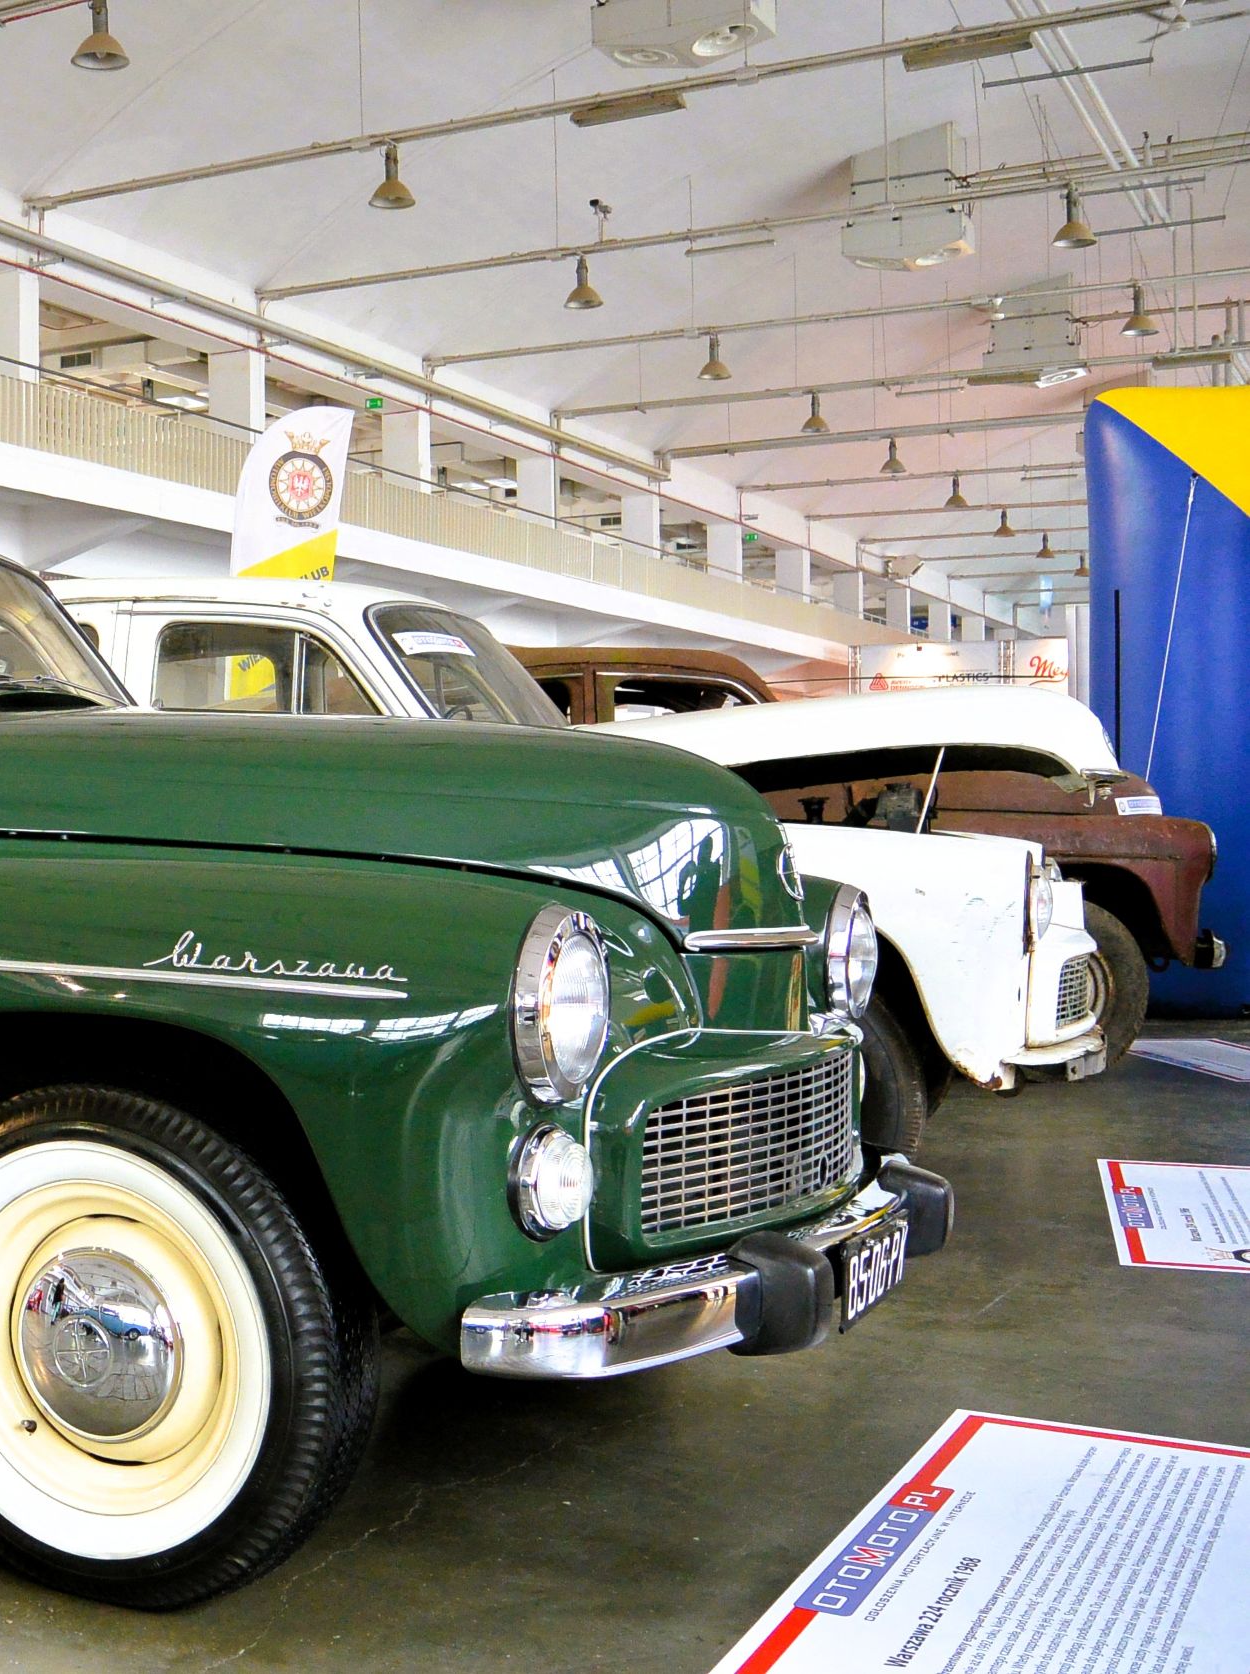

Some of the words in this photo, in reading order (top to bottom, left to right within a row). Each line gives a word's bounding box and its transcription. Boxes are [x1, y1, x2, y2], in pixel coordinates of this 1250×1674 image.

[143, 930, 408, 982] Warszawa
[811, 1486, 942, 1610] OTOMOTO.PL
[864, 1579, 903, 1621] OGŁOSZENIA
[900, 1528, 945, 1576] MOTORYZACYJNE
[946, 1491, 975, 1519] INTERNECIE
[885, 1623, 933, 1666] Warszawa
[918, 1605, 945, 1622] 224
[935, 1576, 967, 1605] rocznik
[953, 1557, 980, 1574] 1968
[943, 1642, 970, 1674] rezentowany
[989, 1656, 1007, 1674] amtego
[1036, 1660, 1049, 1671] ystko
[1059, 1662, 1074, 1670] rozji
[1106, 1657, 1120, 1670] ejności
[1130, 1661, 1141, 1672] wsze
[1175, 1661, 1190, 1674] ednej
